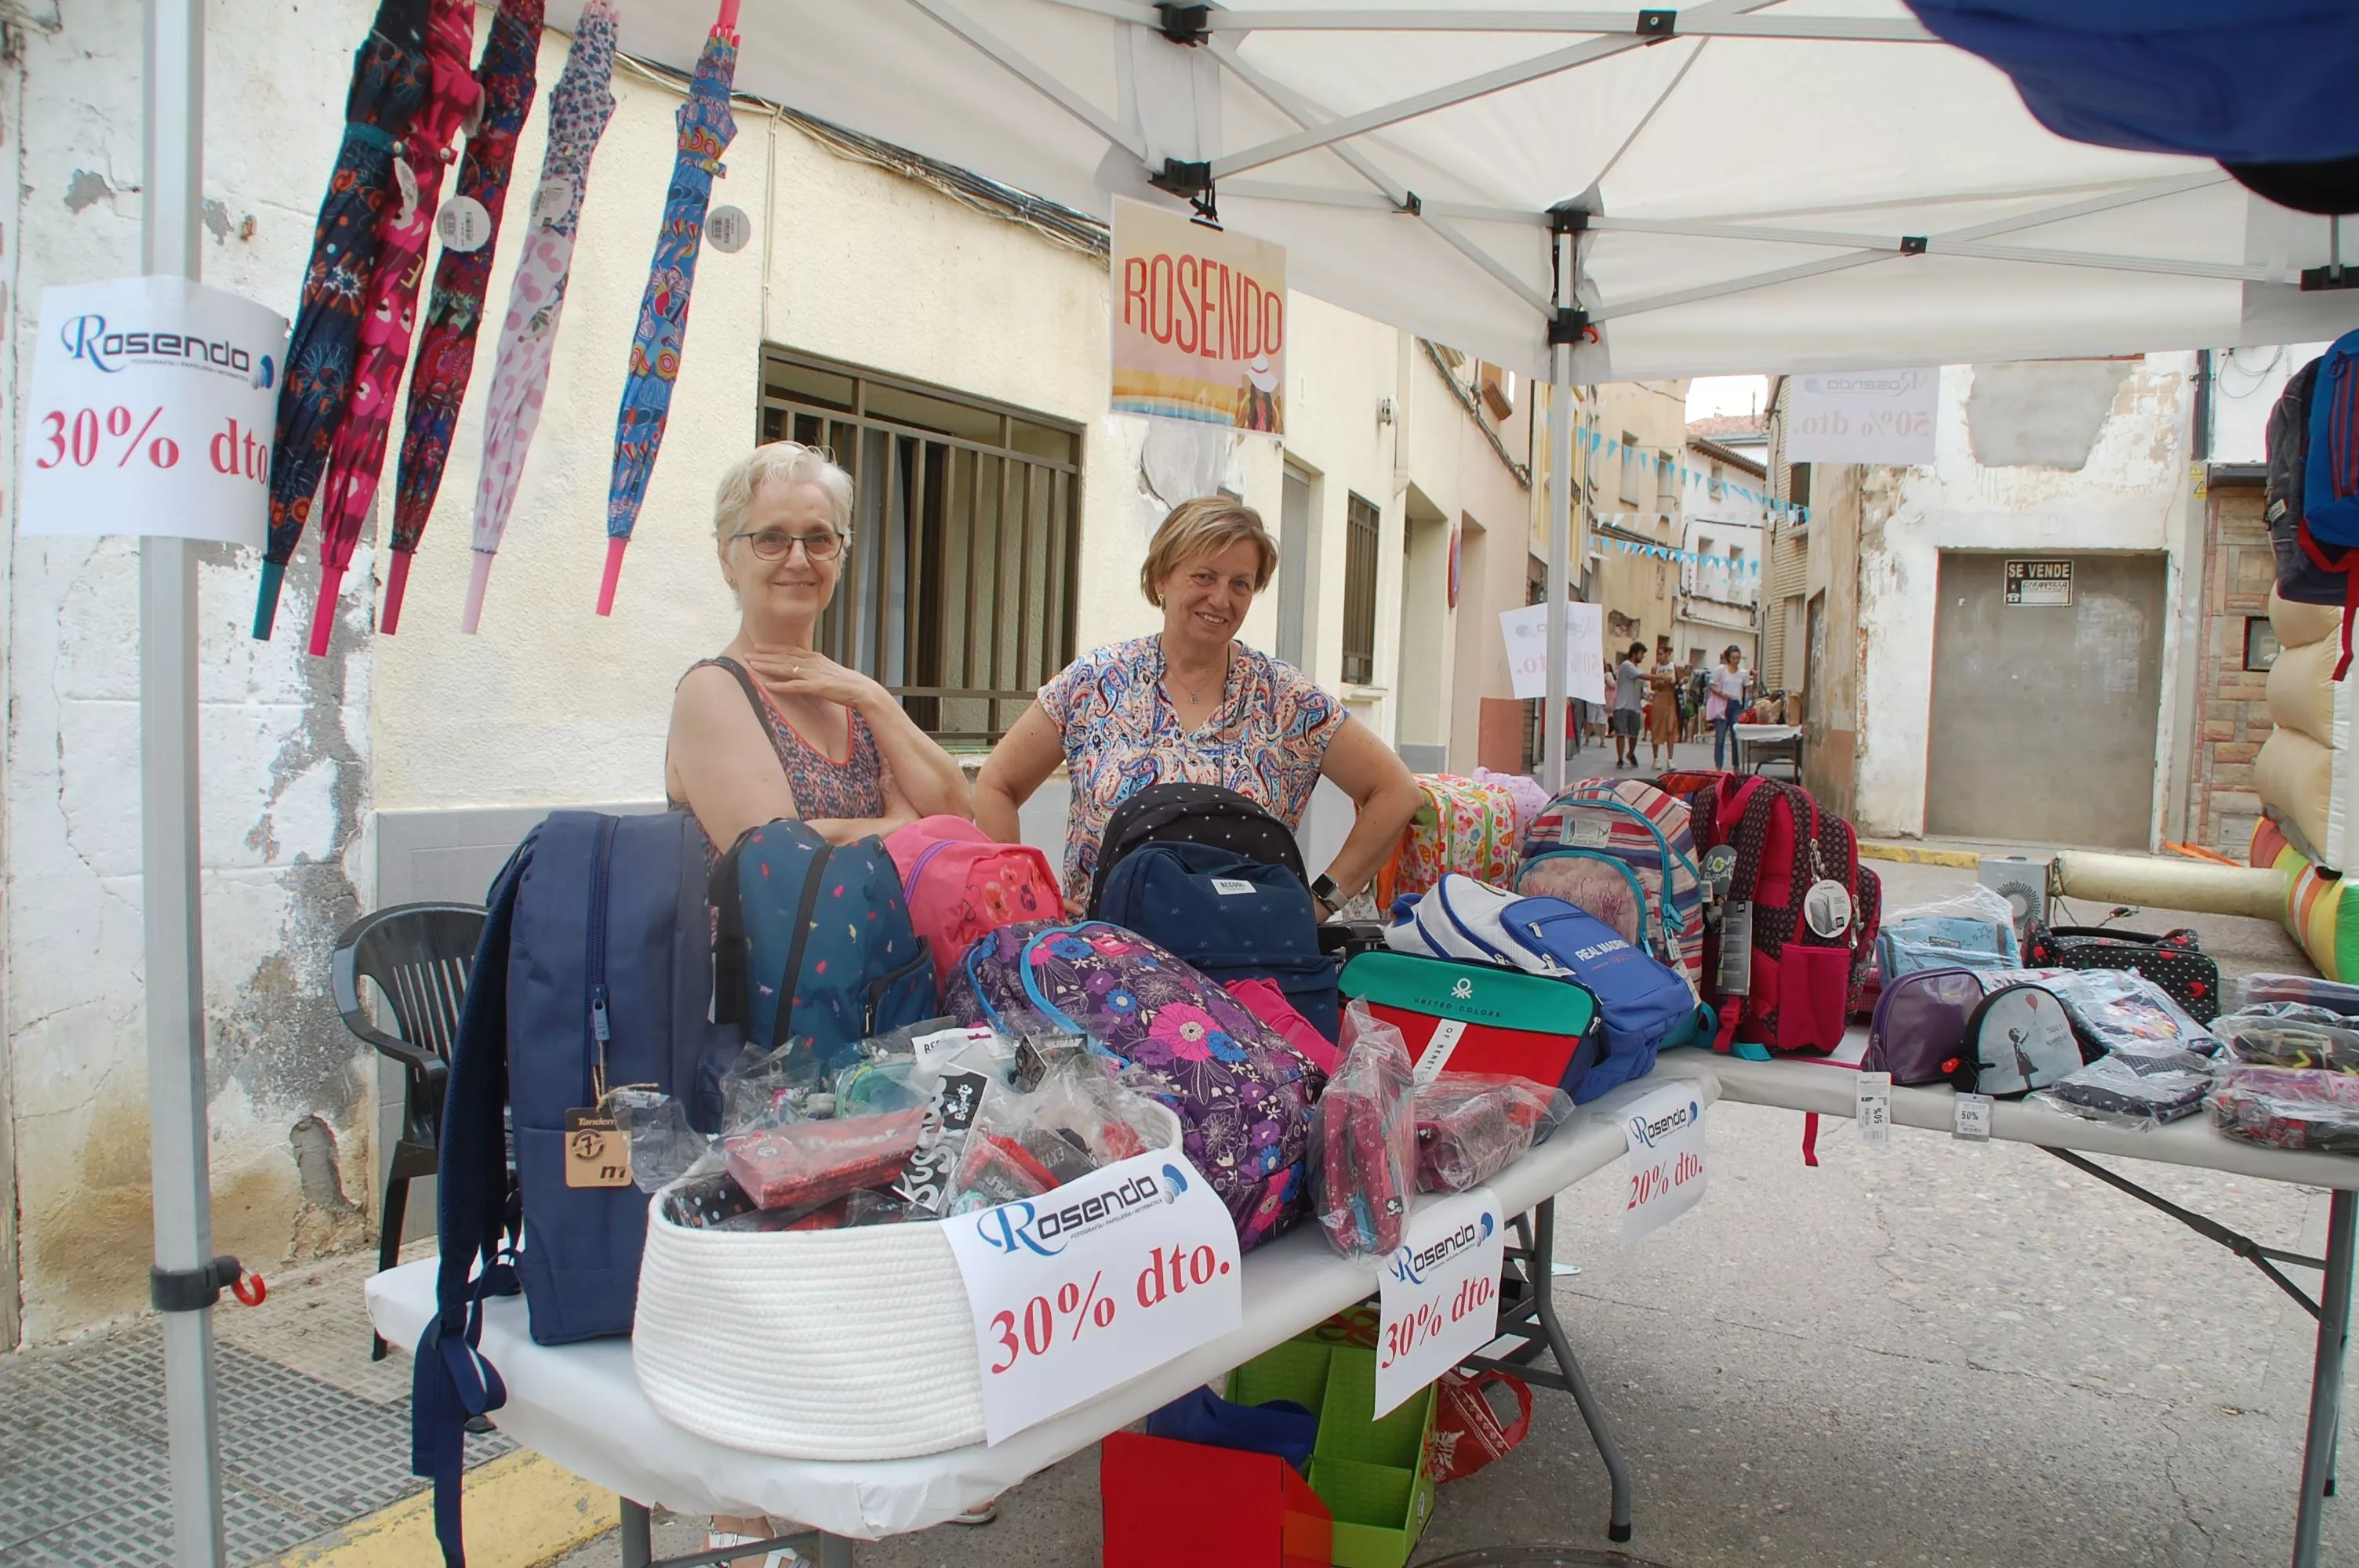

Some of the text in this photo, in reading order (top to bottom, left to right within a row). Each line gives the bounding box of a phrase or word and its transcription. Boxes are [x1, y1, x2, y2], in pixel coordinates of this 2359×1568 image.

[1125, 253, 1283, 361] ROSENDO
[60, 314, 249, 374] Rosendo
[35, 405, 180, 469] 30%
[2008, 564, 2070, 578] SE VENDE
[1575, 946, 1603, 962] REAL
[1413, 996, 1501, 1018] UNITED COLORS
[1444, 1027, 1453, 1039] OF
[1629, 1107, 1687, 1149] Rosendo
[1873, 1107, 1882, 1124] 50%
[1961, 1110, 1979, 1120] 50%
[1627, 1150, 1703, 1211] 20% dto.
[977, 1175, 1159, 1257] Rosendo
[1387, 1224, 1476, 1285] Rosendo
[990, 1243, 1230, 1374] 30% dto.
[1381, 1276, 1495, 1369] 30% dto.
